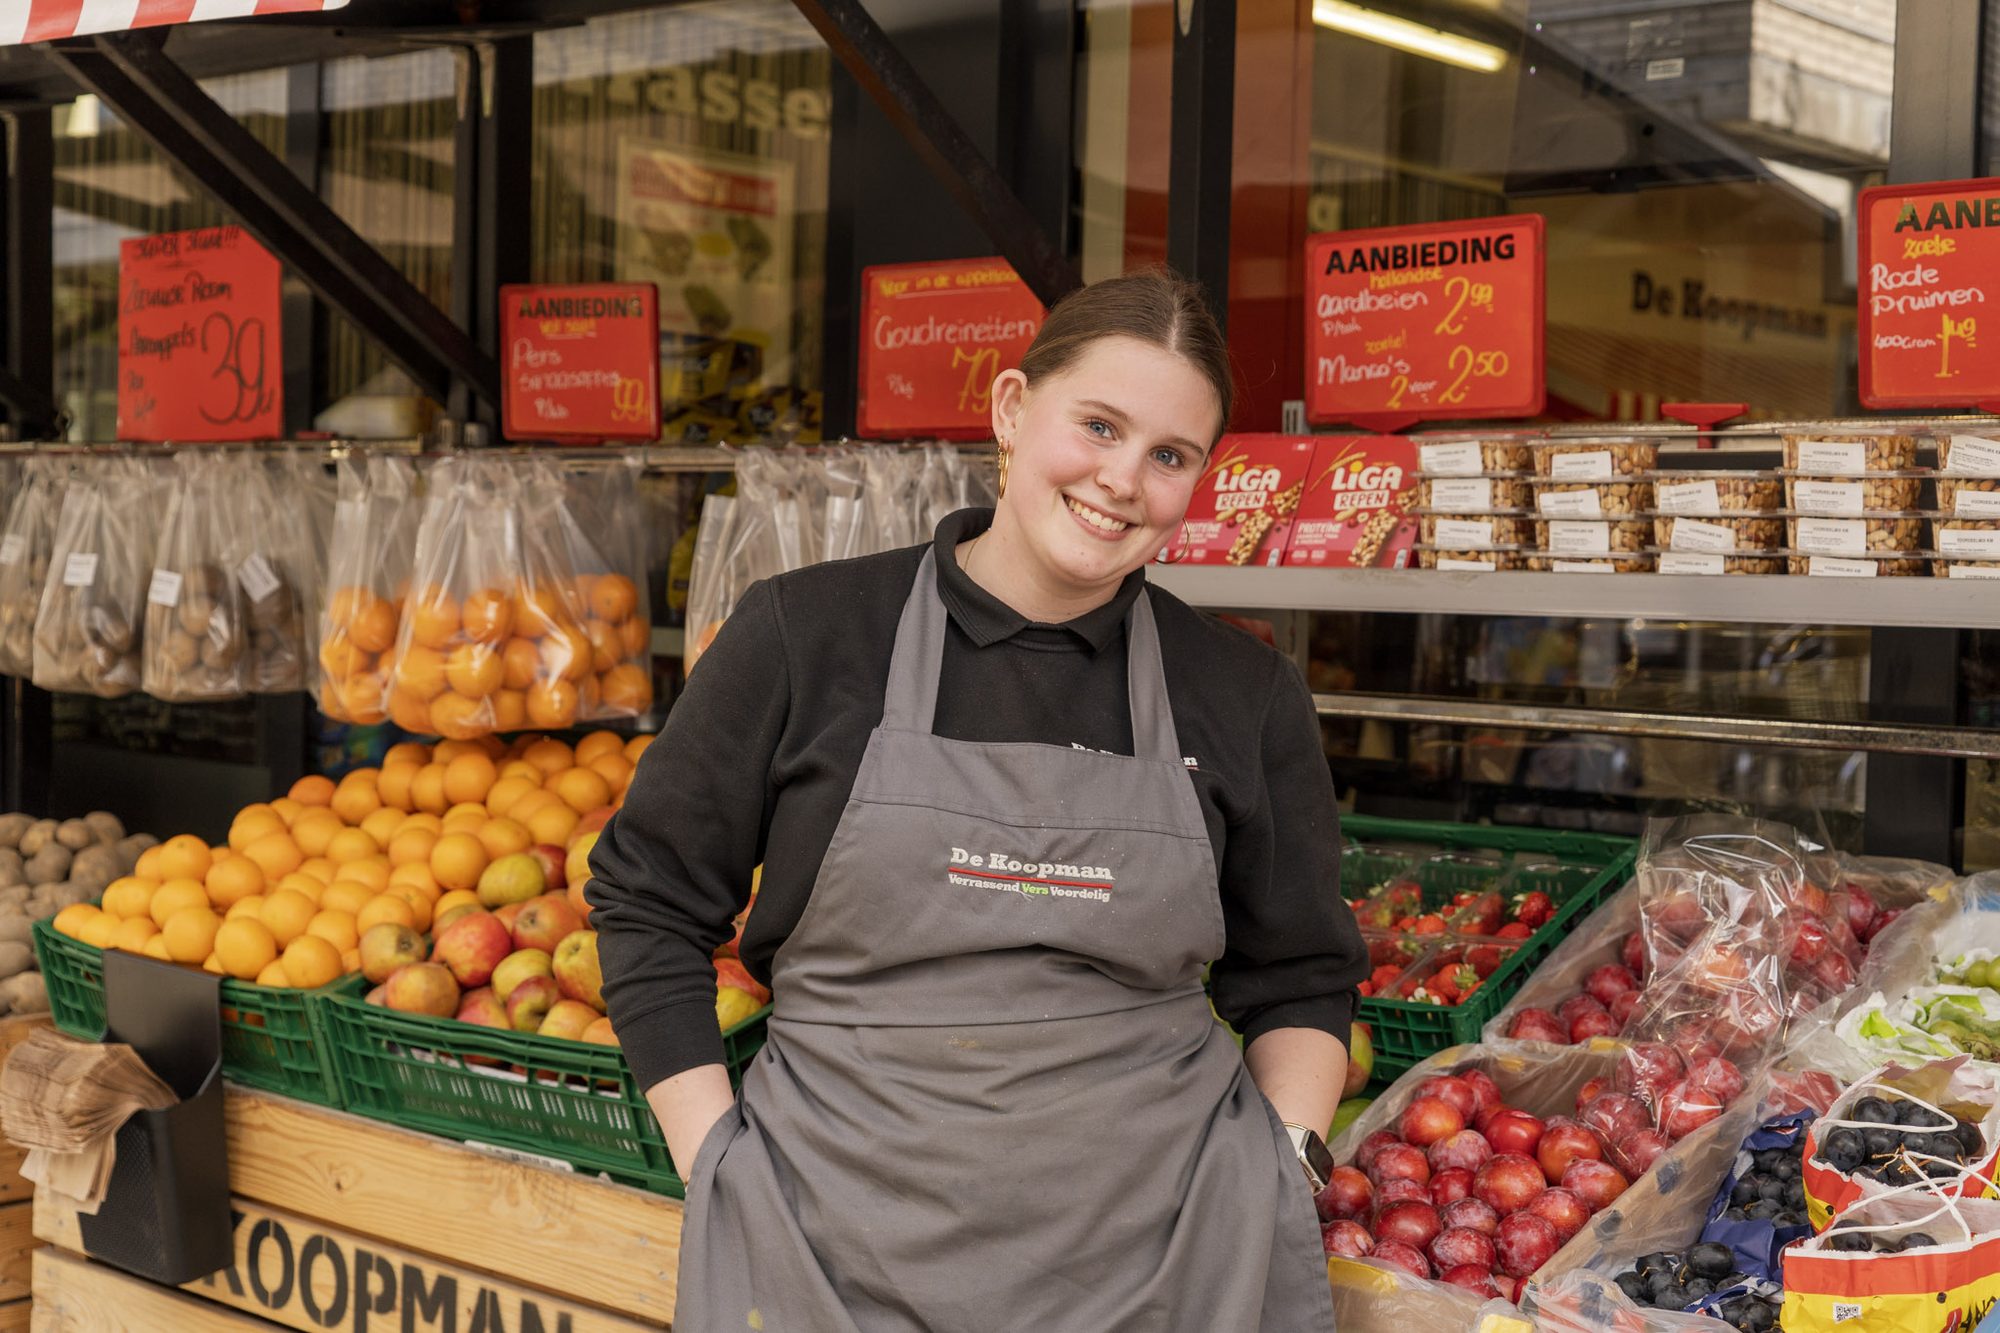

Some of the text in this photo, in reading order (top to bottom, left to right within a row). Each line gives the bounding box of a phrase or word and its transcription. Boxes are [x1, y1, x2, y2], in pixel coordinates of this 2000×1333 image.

[1325, 233, 1516, 275] AANBIEDING
[1632, 270, 1674, 317] De
[1870, 262, 1940, 293] Rode
[519, 295, 643, 318] AANBIEDING
[874, 313, 1037, 350] Goudreinetten
[950, 847, 1115, 881] De Koopman
[949, 873, 1111, 903] Verrassend Vers Voordelig
